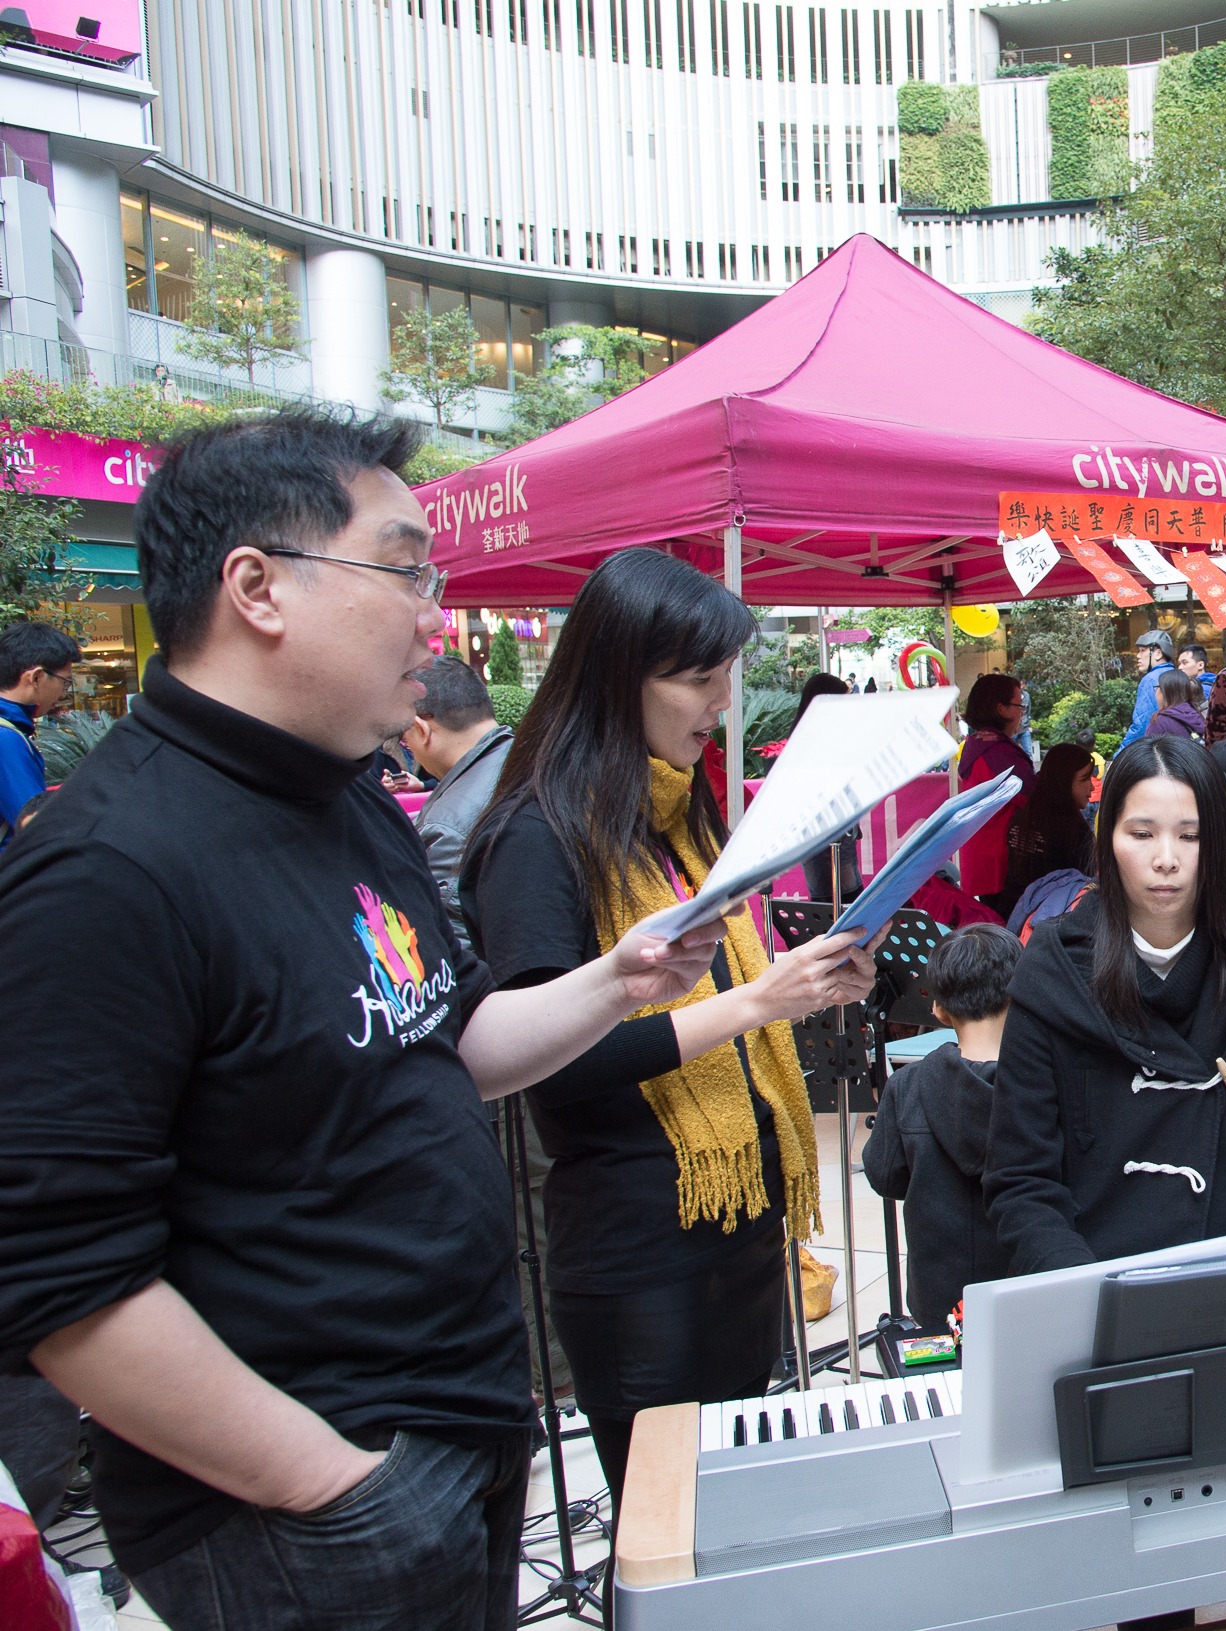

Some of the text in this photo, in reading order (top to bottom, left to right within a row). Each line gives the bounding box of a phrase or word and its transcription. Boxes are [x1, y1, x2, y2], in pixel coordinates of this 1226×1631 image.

[482, 520, 530, 553] 荃新天地
[400, 1003, 450, 1048] FELLOWSHIP
